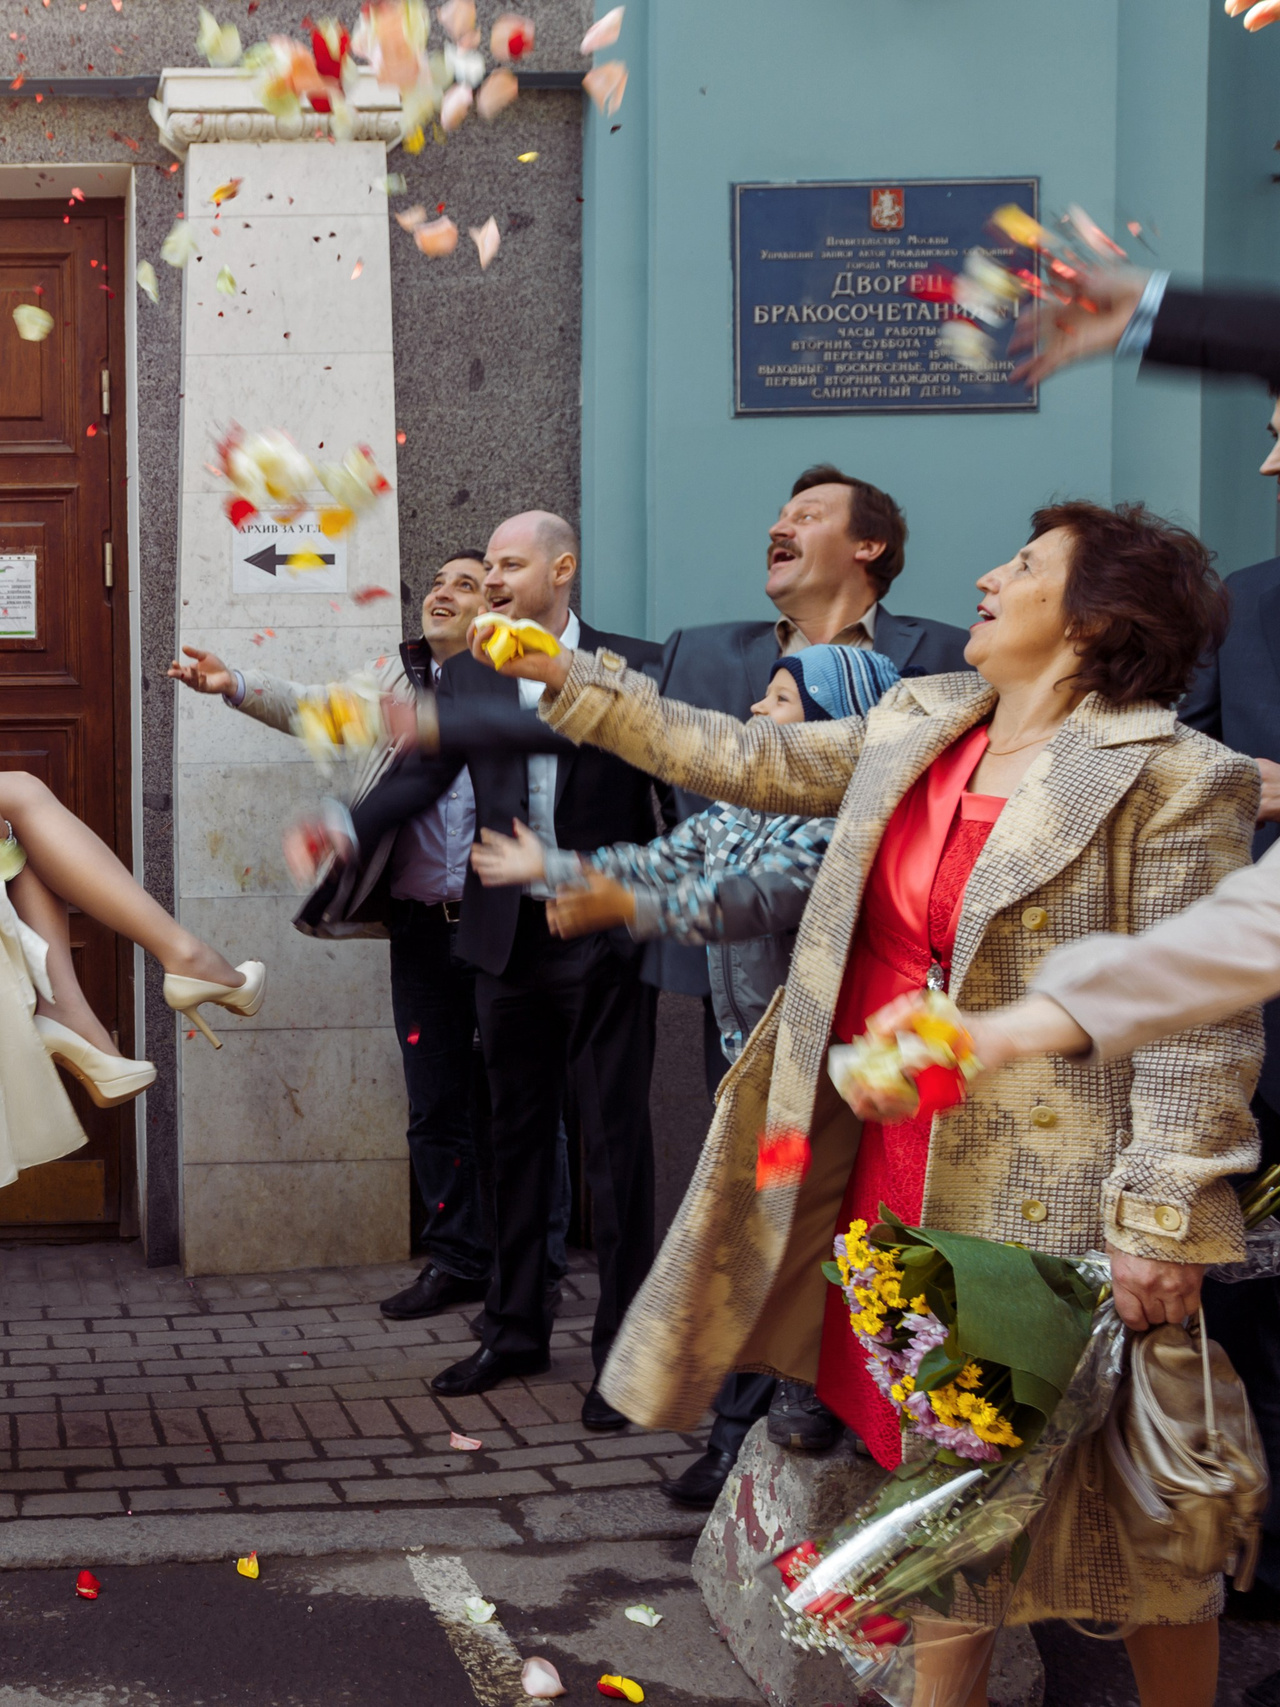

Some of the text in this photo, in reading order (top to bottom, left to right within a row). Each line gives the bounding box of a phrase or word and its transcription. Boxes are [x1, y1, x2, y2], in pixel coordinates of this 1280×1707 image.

[837, 327, 875, 337] ЧАСЫ
[930, 360, 1015, 372] ПОНЕДЬНИК
[765, 371, 1009, 386] ПЕРВЫЙ ВТОРНИК КАЖДОГО МЕСЯЦА
[812, 384, 962, 399] САНИТАРНЫЙ ДЕНЬ
[239, 524, 329, 534] АРХИВ ЗА УГЛ
